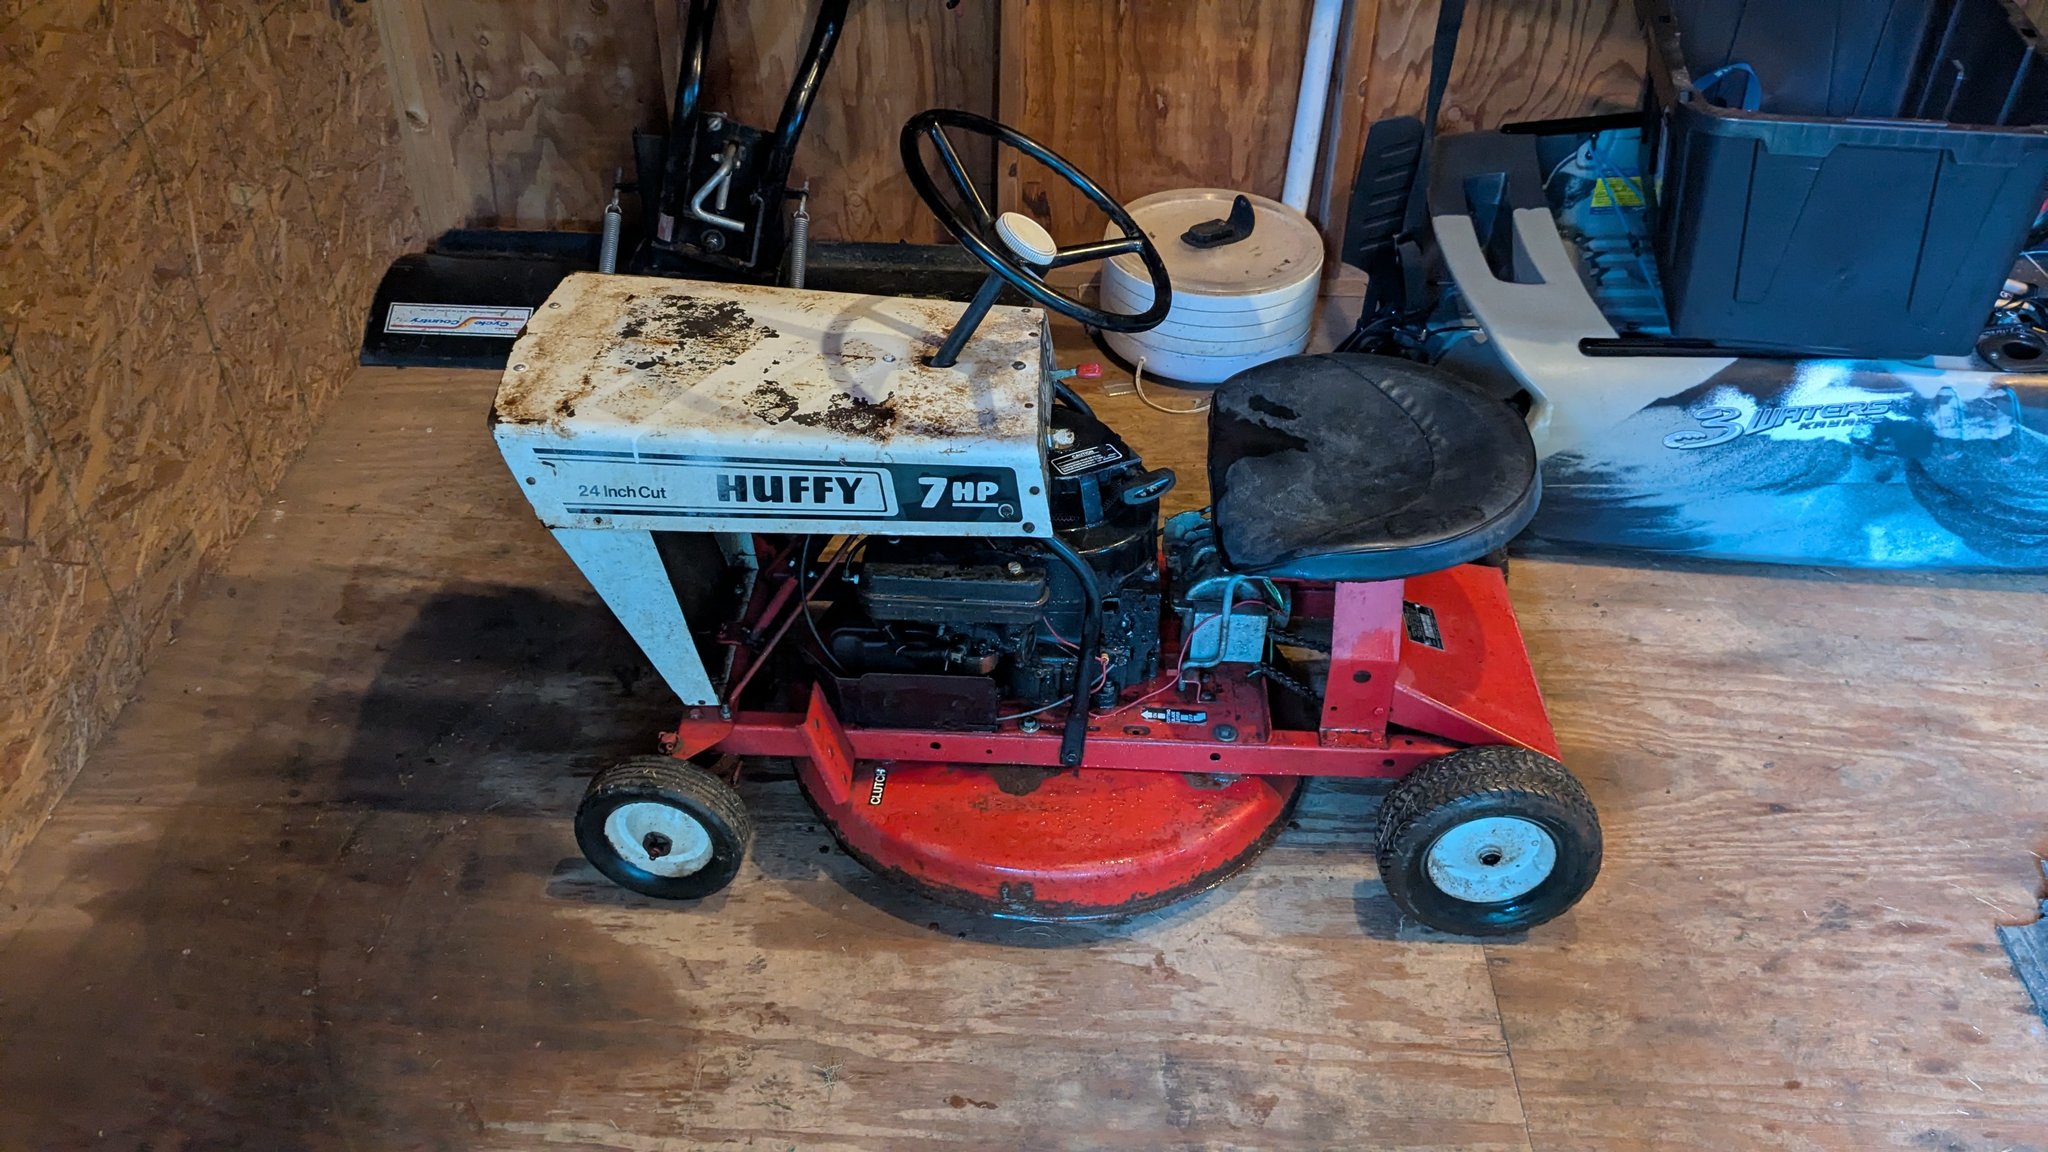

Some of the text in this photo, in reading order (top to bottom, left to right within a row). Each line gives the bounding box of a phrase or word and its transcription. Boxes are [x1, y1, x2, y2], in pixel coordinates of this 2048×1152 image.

[409, 317, 460, 325] Country
[578, 484, 667, 500] 24 Inch Cut
[716, 474, 863, 505] HUFFY
[918, 476, 999, 509] 7 HP
[870, 768, 886, 805] CLUTCH
